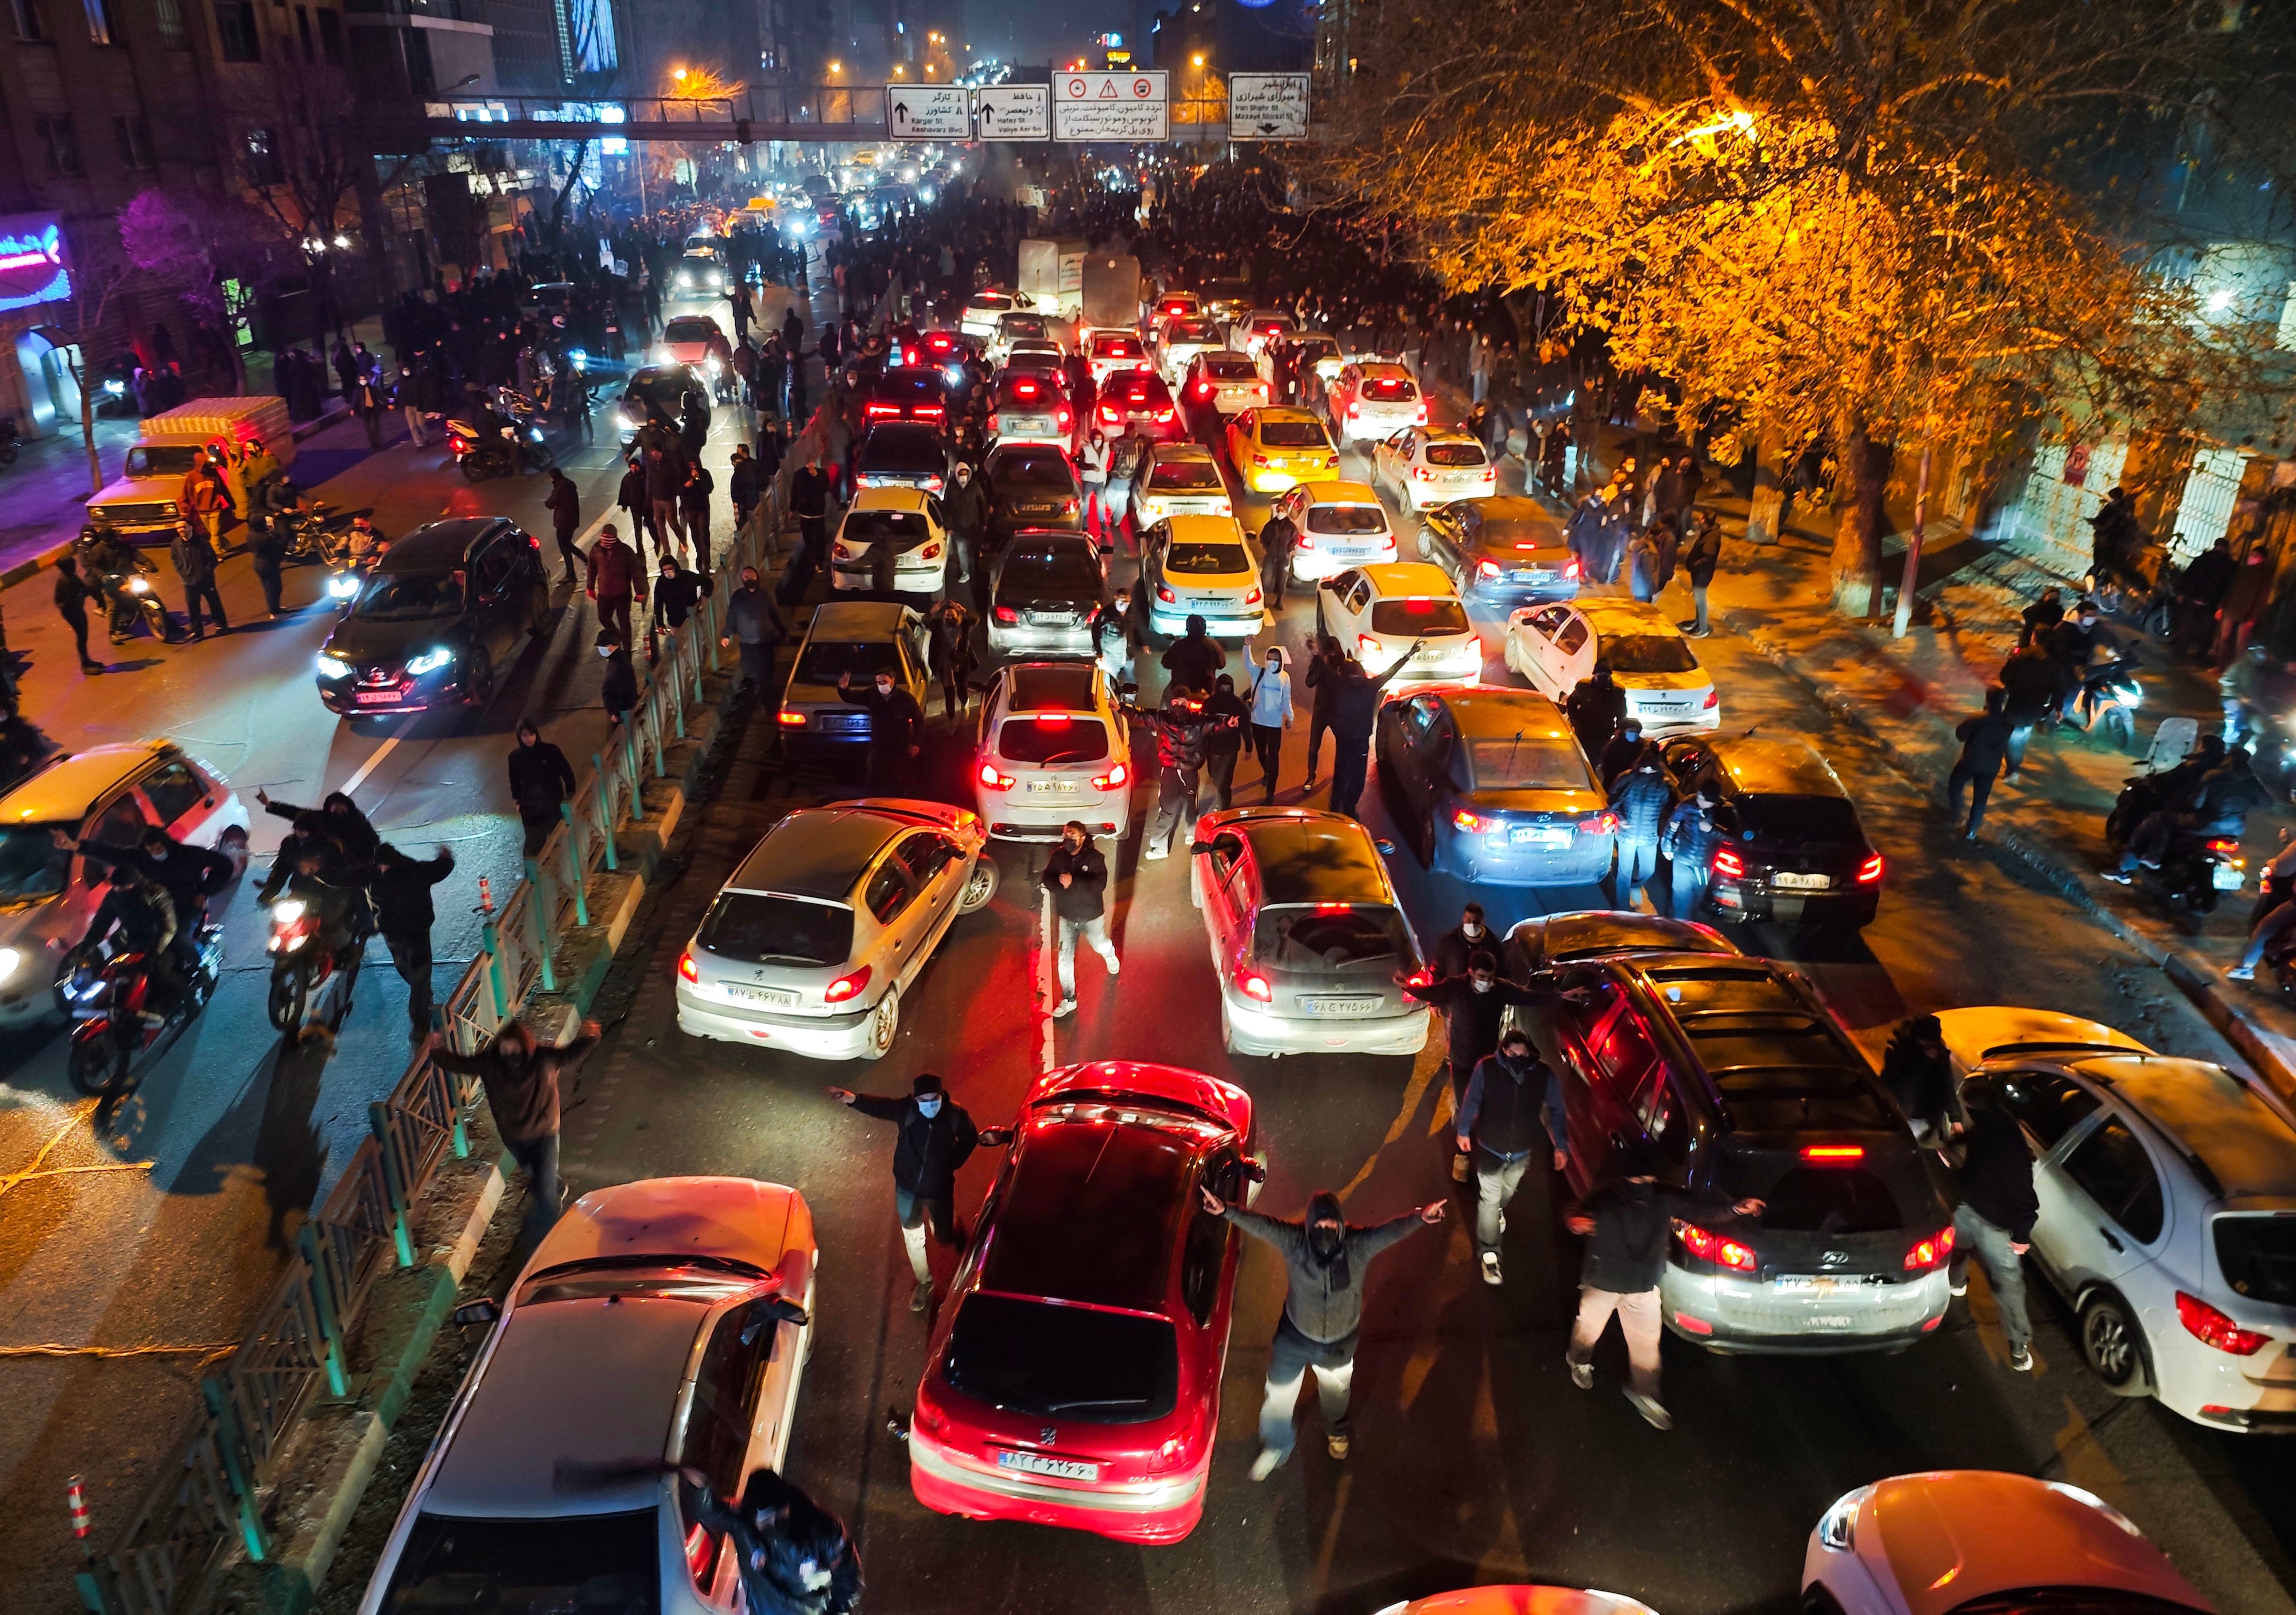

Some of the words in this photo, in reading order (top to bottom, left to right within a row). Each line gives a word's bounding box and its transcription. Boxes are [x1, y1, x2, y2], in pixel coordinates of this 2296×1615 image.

[932, 92, 952, 102] کارگر
[1013, 92, 1033, 100] حافظ
[1236, 92, 1266, 102] شیرازی
[925, 106, 953, 116] کشاورز
[1005, 106, 1034, 115] ولیعصر
[1059, 103, 1079, 114] تریلی
[1146, 104, 1162, 114] تردد
[1064, 115, 1071, 125] از
[1127, 114, 1158, 125] اتوبوس
[1069, 126, 1095, 137] ممنوع
[1095, 125, 1127, 135] کریمخان
[1128, 125, 1138, 135] پل
[1139, 127, 1154, 135] روی
